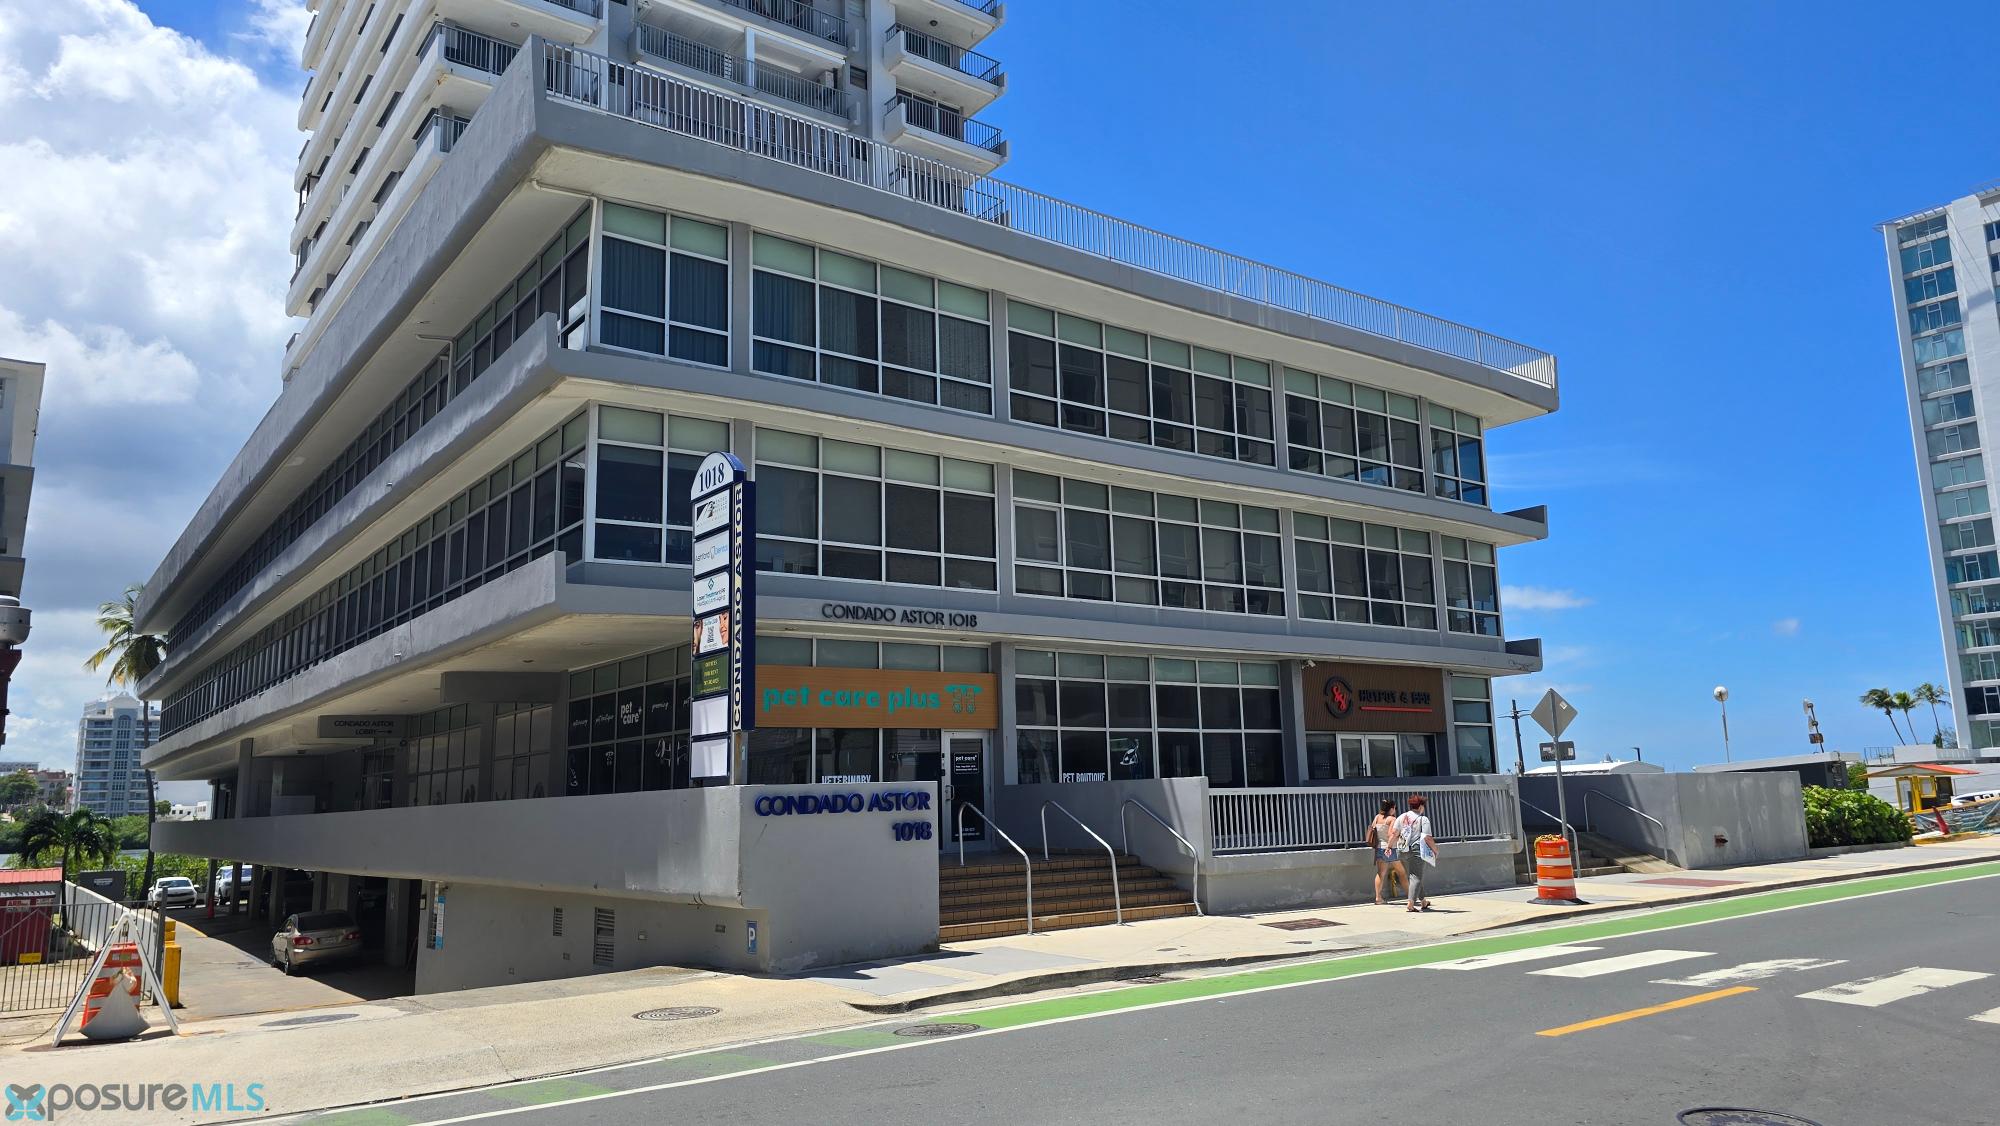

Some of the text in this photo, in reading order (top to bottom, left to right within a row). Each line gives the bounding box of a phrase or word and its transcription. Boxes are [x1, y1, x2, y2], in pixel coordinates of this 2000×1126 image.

[699, 463, 725, 492] 1018
[821, 603, 978, 628] CONDADO ASTOR 1018
[734, 591, 742, 727] CONDADO
[620, 702, 633, 717] pet
[763, 684, 941, 714] pet care plus
[821, 774, 872, 784] VETERINARY
[1062, 772, 1075, 783] PET
[754, 791, 931, 817] CONDADO ASTOR
[892, 821, 933, 842] 1018
[748, 927, 756, 947] P
